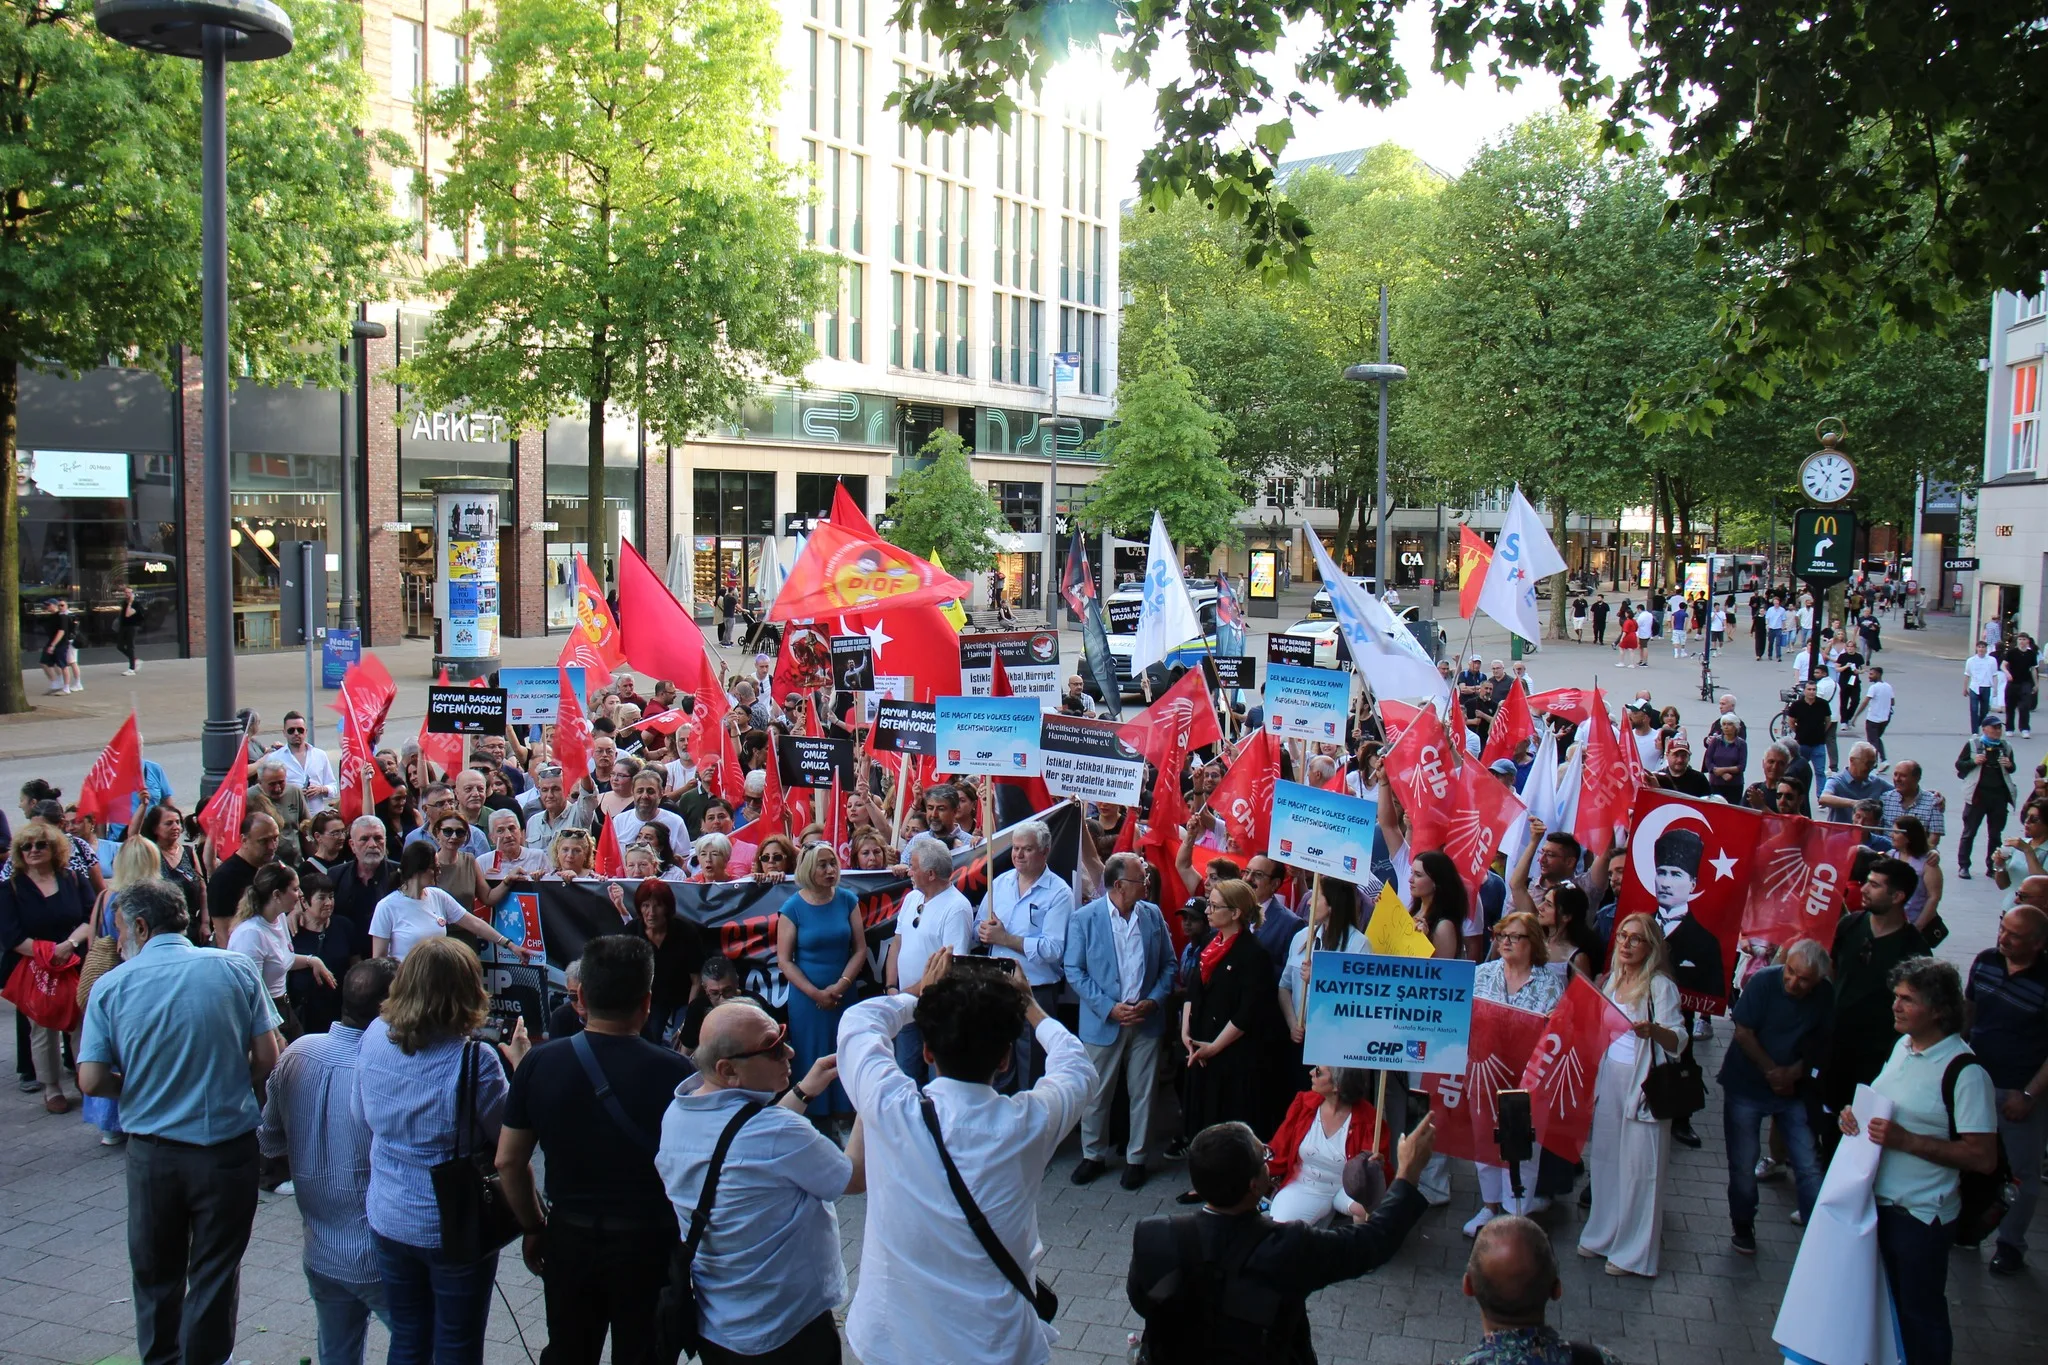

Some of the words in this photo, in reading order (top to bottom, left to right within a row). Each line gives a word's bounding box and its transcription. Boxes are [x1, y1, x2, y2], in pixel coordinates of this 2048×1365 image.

[412, 410, 503, 443] ARKET
[385, 523, 410, 531] ARKET
[534, 523, 558, 531] ARKET
[1401, 552, 1424, 566] C&A
[145, 562, 168, 573] Apollo
[1944, 561, 1973, 569] CHRIST
[1112, 612, 1140, 621] KAZANAC
[996, 640, 1028, 649] Gemeinde
[967, 649, 1014, 658] Hambur-Mitte
[970, 673, 991, 683] İstikla
[1281, 675, 1296, 684] WILLE
[1296, 677, 1307, 685] DES
[1307, 679, 1327, 687] VOLKES
[1327, 681, 1344, 689] KANN
[972, 686, 984, 695] Her
[1293, 688, 1311, 697] KEINER
[1312, 690, 1330, 698] MACHT
[433, 694, 466, 703] KAYYUM
[469, 695, 502, 704] BAŞKAN
[1274, 697, 1310, 706] AUFGEHALTEN
[1310, 700, 1332, 709] WERDEN
[433, 703, 503, 716] İSTEMİYORUZ
[881, 708, 909, 718] KAYYUM
[911, 710, 936, 721] BAŞKA
[951, 712, 972, 720] MACHT
[1012, 714, 1035, 722] GEGEN
[956, 724, 1013, 734] RECHTSWIDRIGKEIT
[1081, 727, 1114, 738] Gemeinde
[1048, 732, 1099, 746] Hamburg-Mitte
[819, 742, 835, 751] karşı
[803, 750, 828, 760] OMUZ
[976, 751, 992, 759] CHP
[801, 761, 831, 771] OMUZA
[1046, 755, 1072, 769] İstiklal
[1045, 770, 1060, 780] Her
[1061, 772, 1074, 784] şey
[1075, 774, 1105, 787] adaletle
[1061, 784, 1081, 792] Mustafa
[1082, 787, 1097, 796] Kemal
[1098, 789, 1117, 798] Atatürk
[1288, 799, 1308, 810] MACHT
[1309, 806, 1321, 815] DES
[1321, 808, 1346, 821] VOLKES
[1347, 815, 1371, 826] GEGEN
[1291, 813, 1347, 835] RECHTSWIDRIGKEIT
[1308, 847, 1324, 857] CHP
[526, 938, 542, 948] CHP
[1342, 960, 1443, 981] EGEMENLİK
[1315, 980, 1392, 998] KAYITSIZ
[1397, 985, 1467, 1003] ŞARTSIZ
[488, 1000, 521, 1013] BURG
[1680, 992, 1716, 1013] DEYİZ
[1333, 1000, 1443, 1023] MİLLETİNDİR
[1393, 1024, 1416, 1032] Mustafa
[1367, 1041, 1404, 1056] CHP
[1343, 1055, 1377, 1063] HAMBURG
[1379, 1055, 1403, 1064] BİRLİĞİ
